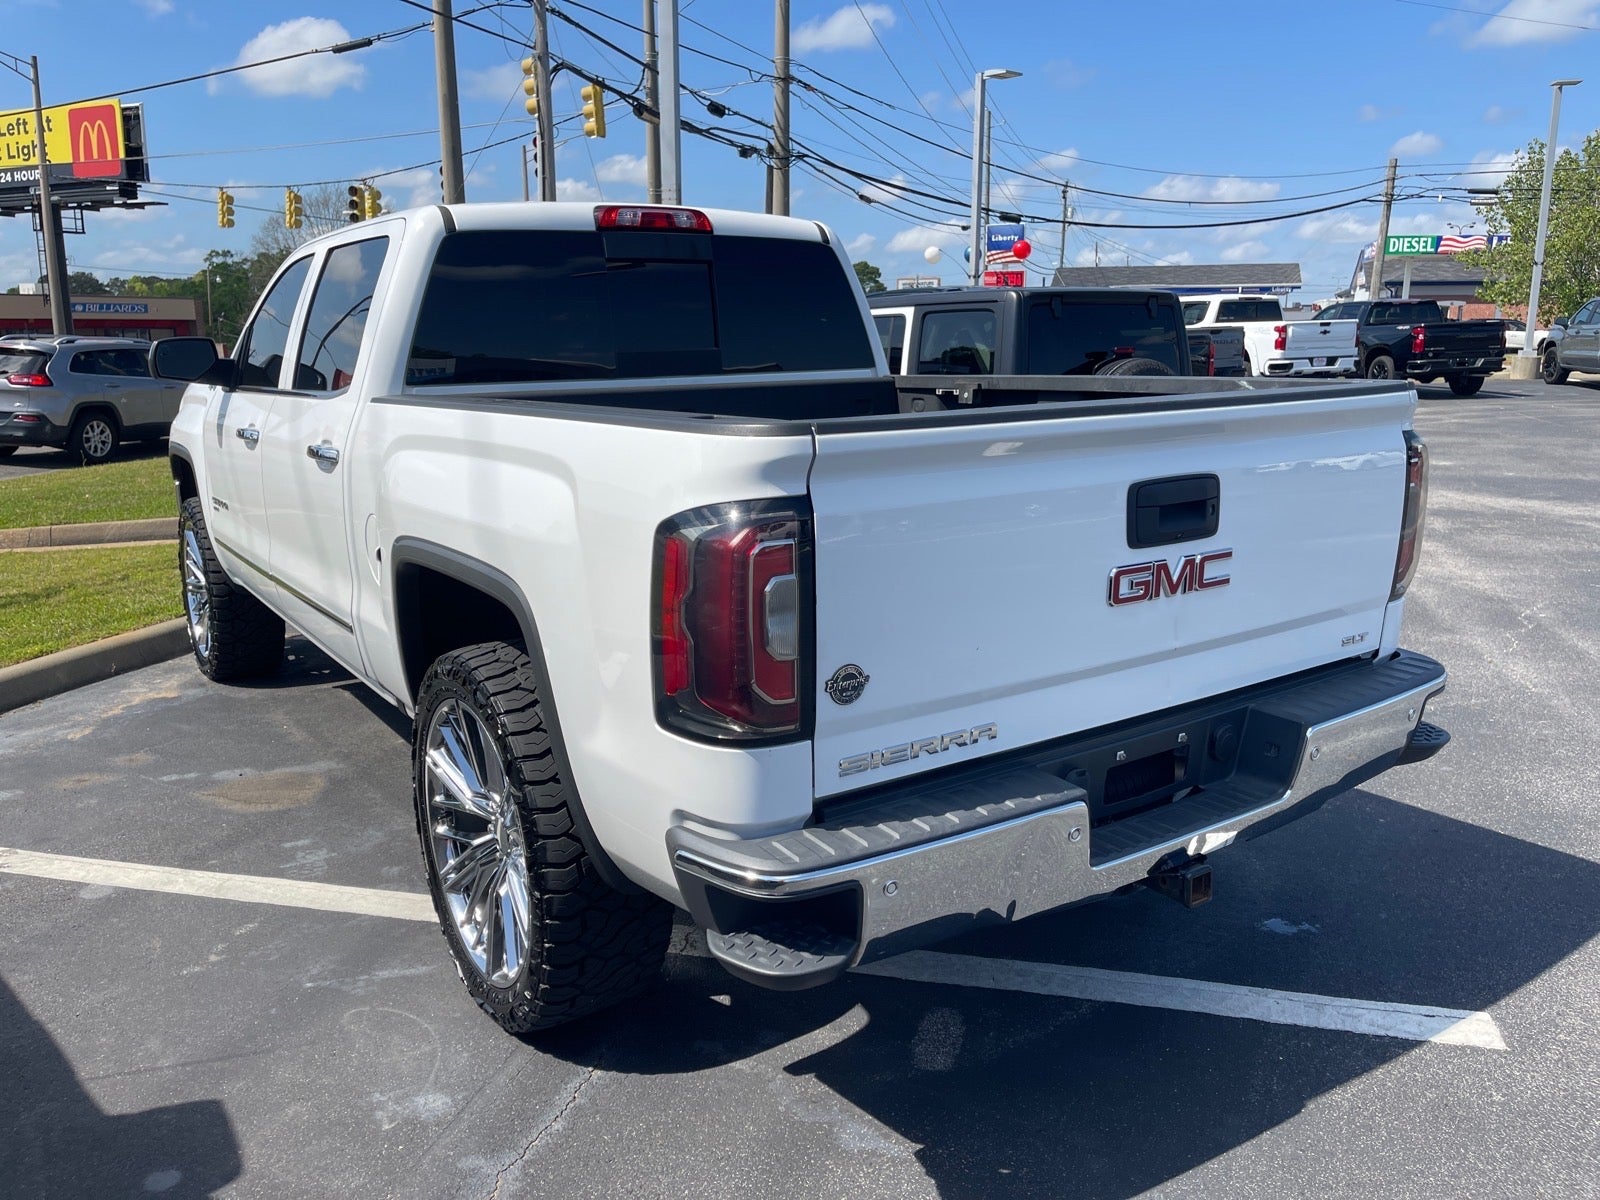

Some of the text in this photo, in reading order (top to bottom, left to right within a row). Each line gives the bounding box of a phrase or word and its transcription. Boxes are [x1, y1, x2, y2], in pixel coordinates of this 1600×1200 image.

[34, 116, 53, 134] t
[0, 169, 42, 183] 24 HOUR
[991, 234, 1019, 242] Liberty
[1389, 237, 1435, 253] DIESEL
[85, 303, 145, 312] BILLIARDS
[1106, 547, 1233, 607] GMC
[1341, 631, 1369, 647] SLT
[838, 721, 998, 777] SIERRA
